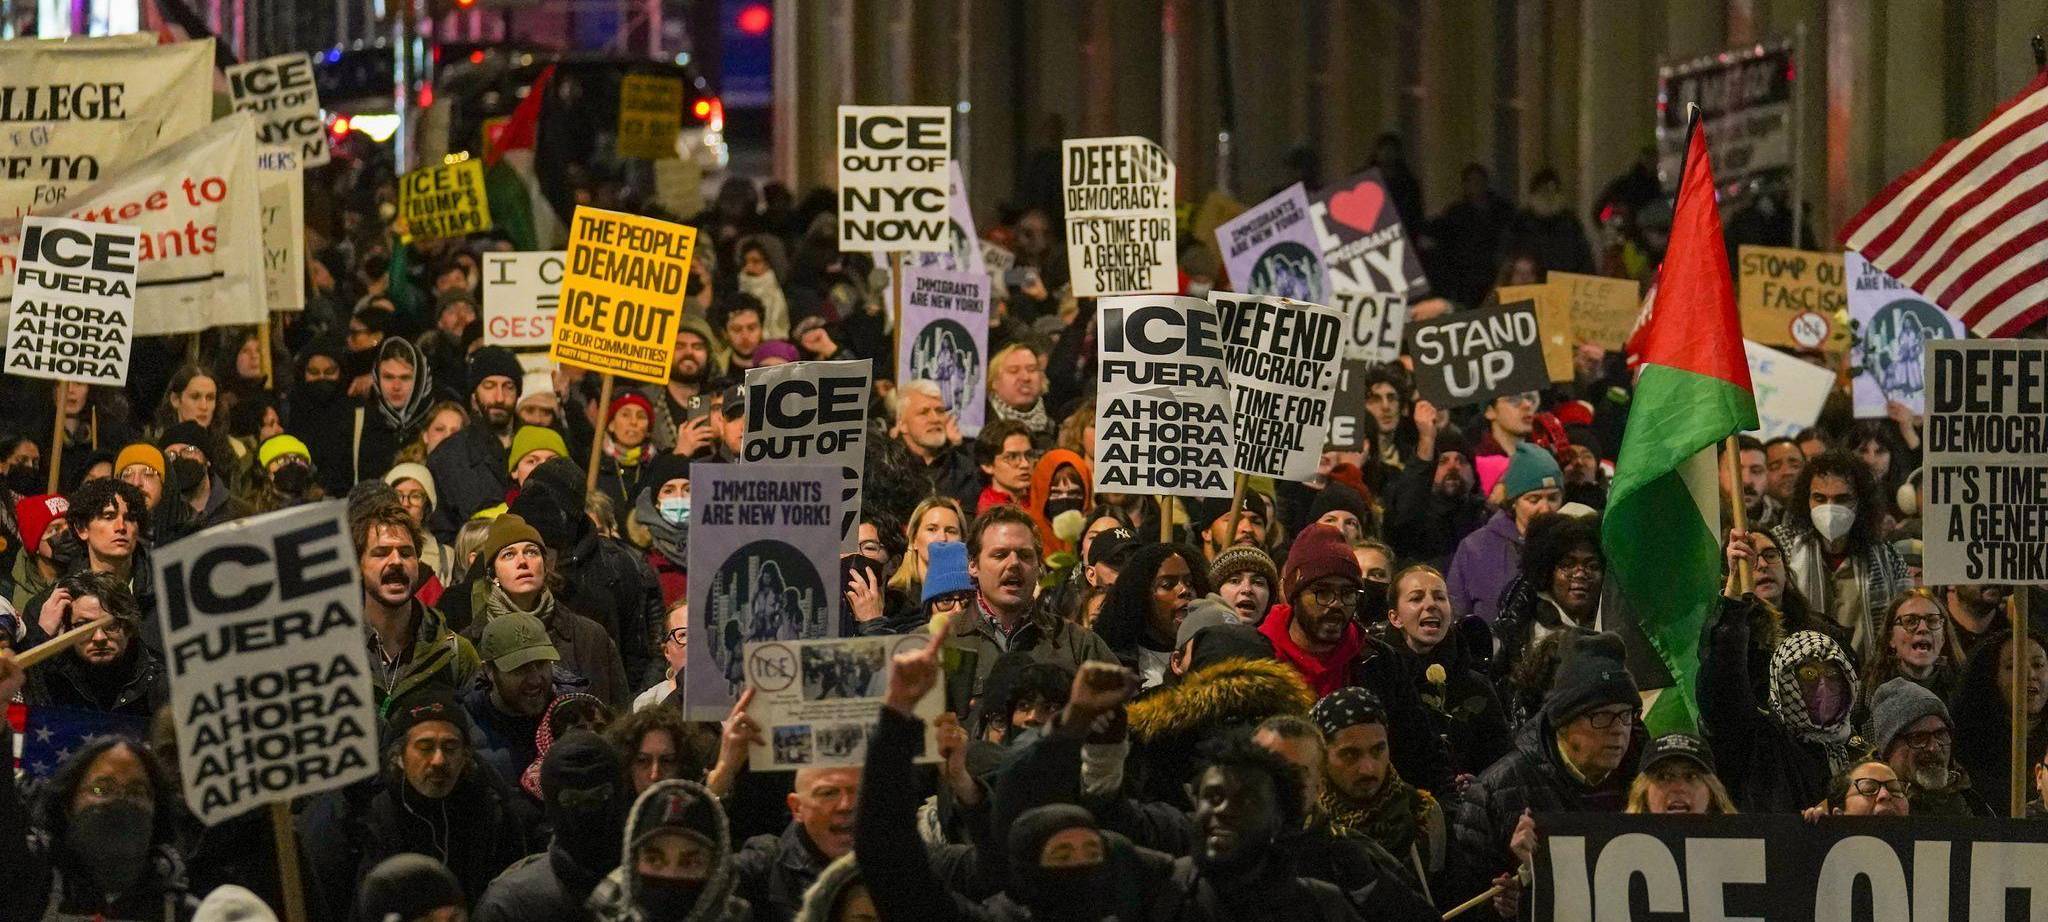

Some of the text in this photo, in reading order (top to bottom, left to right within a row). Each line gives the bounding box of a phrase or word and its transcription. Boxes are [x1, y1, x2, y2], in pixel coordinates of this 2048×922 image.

[230, 60, 312, 99] ICE
[0, 82, 126, 121] LLEGE
[283, 89, 313, 107] OF
[844, 116, 946, 150] ICE
[405, 169, 452, 193] ICE
[843, 156, 946, 172] OUT OF
[1069, 144, 1168, 186] DEFEND
[182, 176, 227, 206] to
[843, 187, 945, 213] NYC
[1068, 186, 1169, 211] DEMOCRACY:
[578, 216, 691, 261] THE PEOPLE
[844, 219, 945, 242] NOW
[1072, 218, 1171, 246] IT'S TIME FOR
[22, 226, 135, 274] ICE
[1084, 241, 1162, 269] A GENERAL
[1327, 237, 1409, 293] NY
[1743, 254, 1807, 280] STOMP
[17, 267, 132, 299] FUERA
[572, 244, 683, 295] DEMAND
[1096, 266, 1152, 292] STRIKE!
[1856, 276, 1904, 290] ARE NE
[910, 292, 929, 307] ARE
[930, 294, 953, 311] NEW
[916, 277, 979, 299] IMMIGRANTS
[13, 317, 125, 345] AHORA
[15, 300, 127, 327] AHORA
[563, 288, 675, 345] ICE OUT
[1216, 299, 1341, 362] DEFEND
[11, 335, 123, 362] AHORA
[559, 328, 572, 342] OF
[573, 332, 593, 349] OUR
[593, 337, 668, 363] COMMUNITIES!
[1103, 306, 1224, 359] ICE
[1415, 311, 1537, 365] STAND
[9, 352, 121, 379] AHORA
[1102, 360, 1231, 390] FUERA
[1223, 344, 1332, 391] MOCRACY:
[1443, 350, 1514, 398] UP
[1934, 349, 2048, 414] DEFE
[749, 377, 867, 433] ICE
[1102, 398, 1229, 424] AHORA
[1235, 384, 1327, 427] TIME FOR
[744, 428, 862, 463] OUT OF
[1101, 421, 1229, 446] AHORA
[1101, 443, 1228, 468] AHORA
[1234, 440, 1289, 476] RIKE!
[712, 480, 822, 503] IMMIGRANTS
[1100, 465, 1228, 490] AHORA
[1931, 466, 2048, 504] IT'S TIME
[702, 504, 733, 526] ARE
[738, 503, 776, 525] NEW
[782, 503, 831, 526] YORK!
[1948, 504, 1965, 541] A
[163, 518, 354, 632] ICE
[1966, 541, 2048, 580] STRIK
[173, 600, 356, 676] FUERA
[186, 654, 361, 726] AHORA
[190, 685, 363, 756] AHORA
[194, 716, 366, 787] AHORA
[201, 748, 368, 816] AHORA
